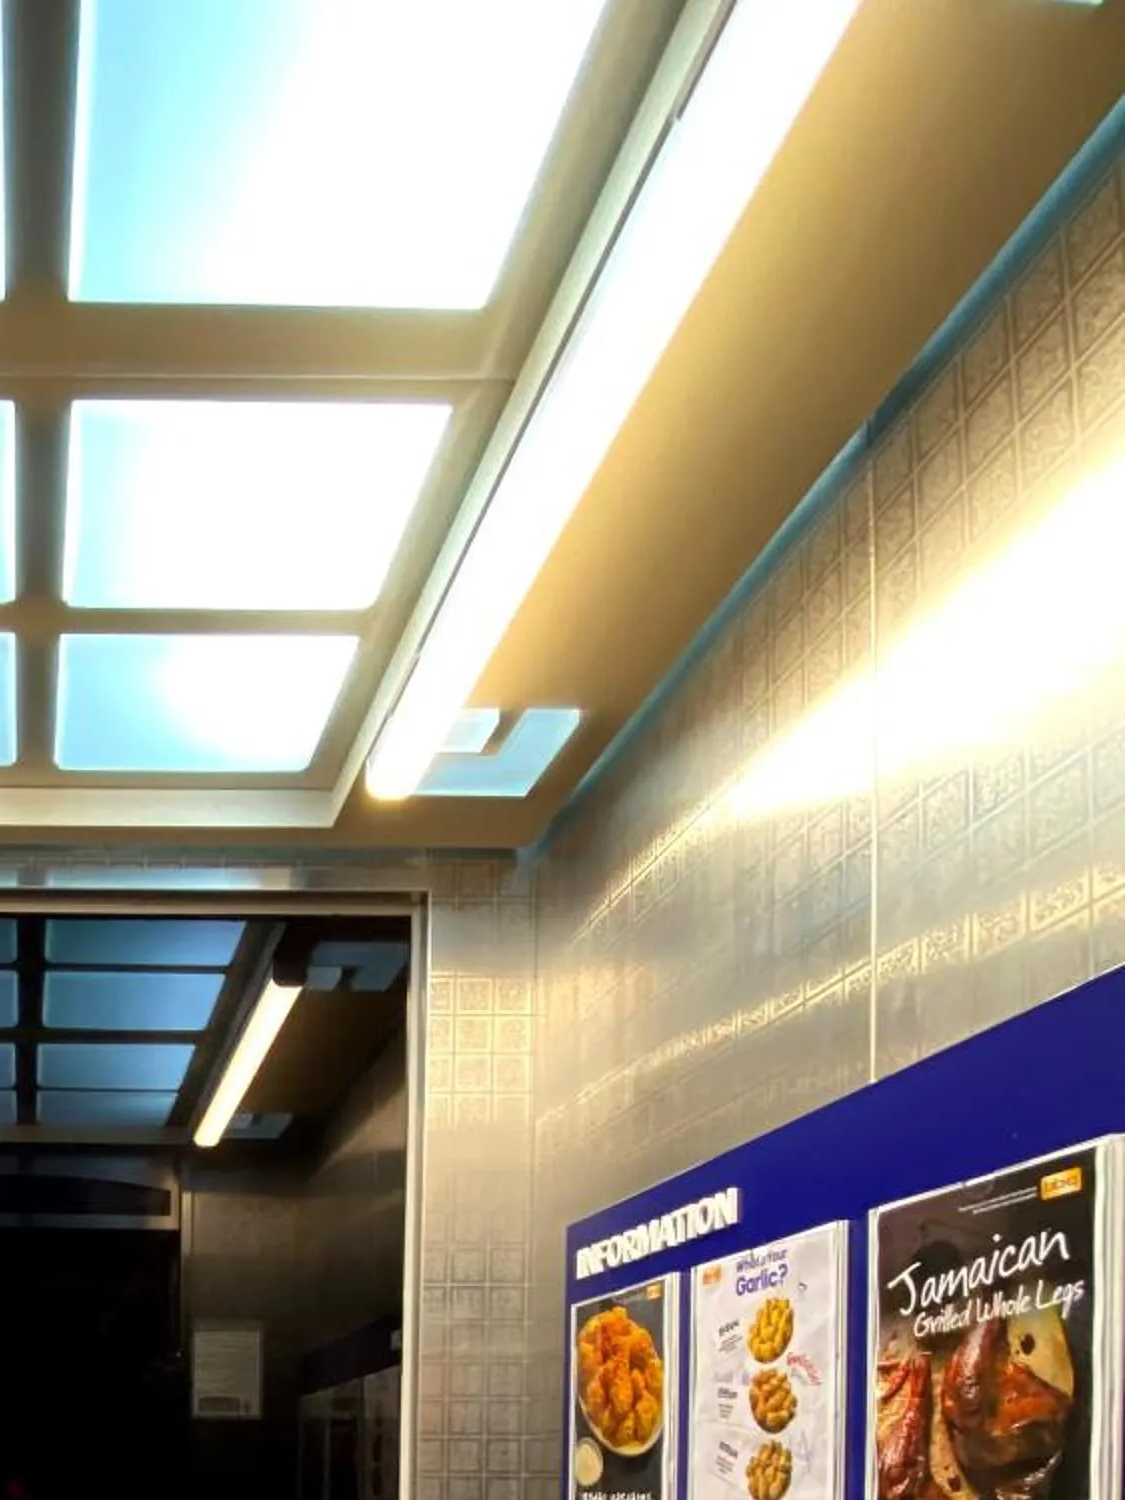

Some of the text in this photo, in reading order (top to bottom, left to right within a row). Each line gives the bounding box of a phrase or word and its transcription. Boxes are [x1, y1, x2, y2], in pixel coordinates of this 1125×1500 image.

[576, 1187, 740, 1280] INFORMATION
[736, 1263, 788, 1296] Garlic?
[887, 1230, 1070, 1316] Jamaican
[913, 1279, 1086, 1337] Grilled Whole Legs
